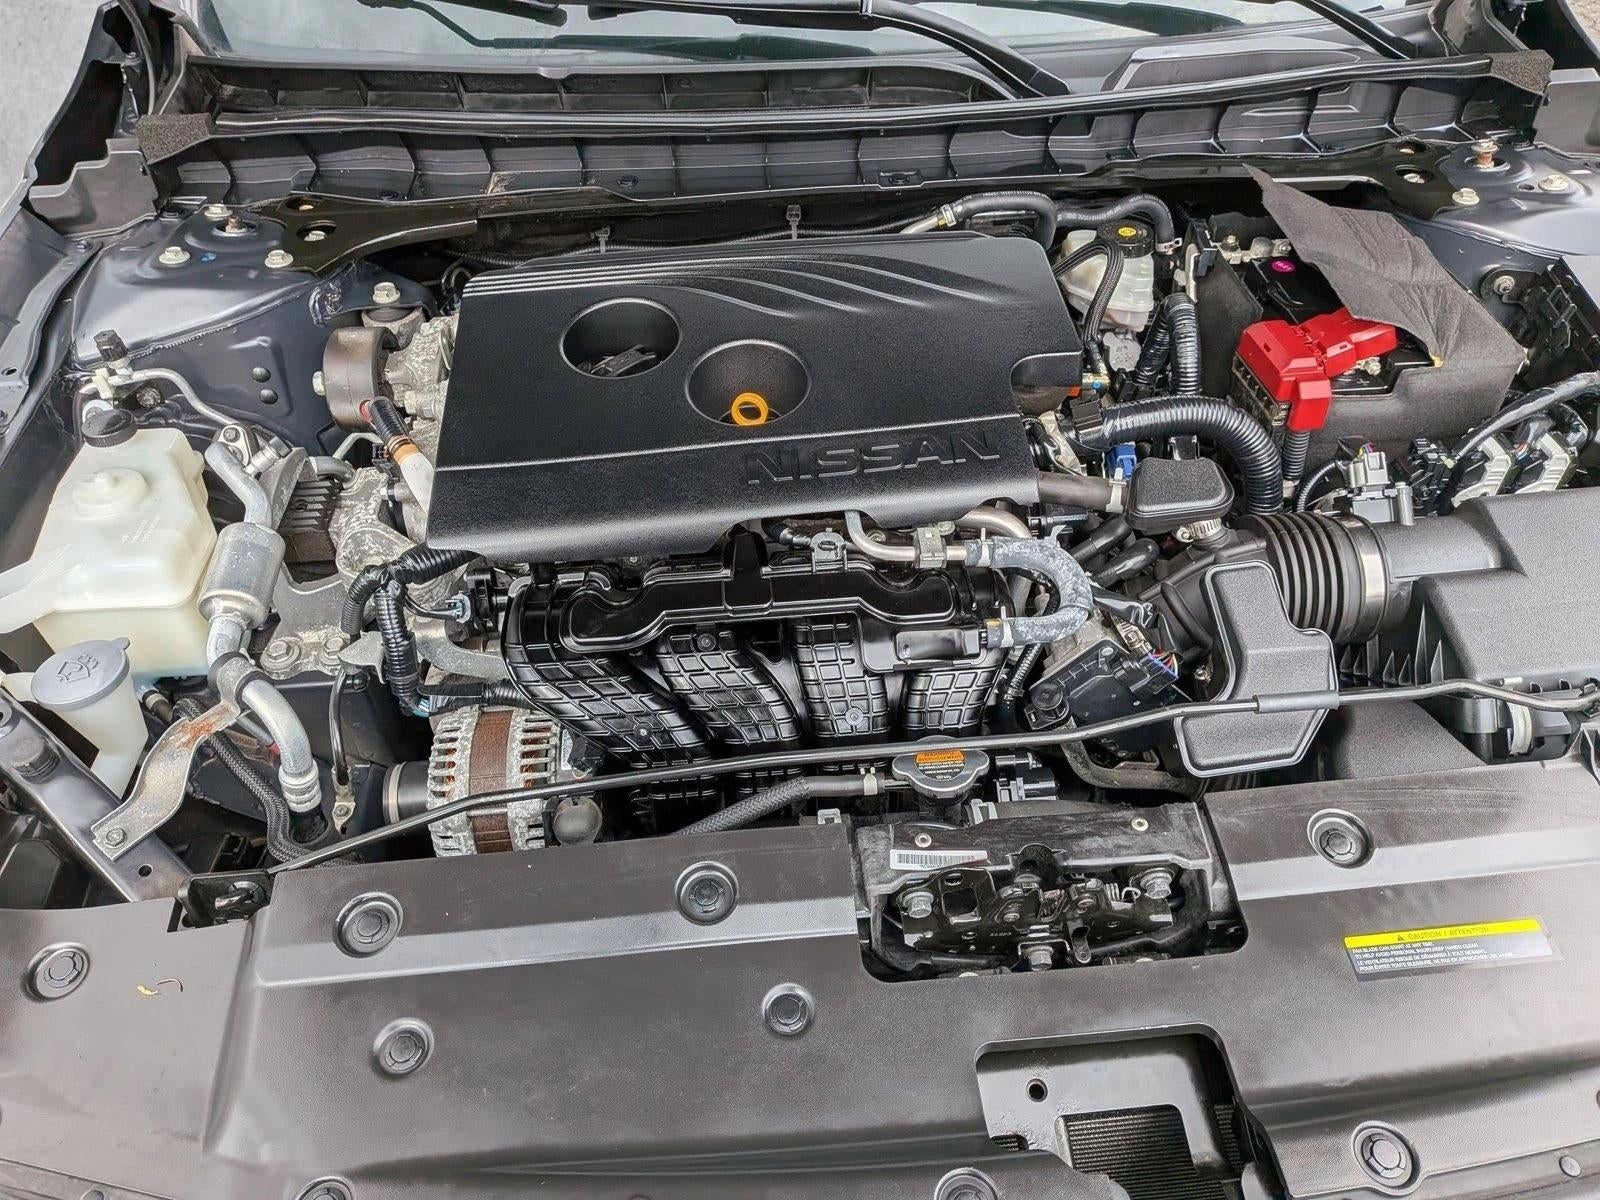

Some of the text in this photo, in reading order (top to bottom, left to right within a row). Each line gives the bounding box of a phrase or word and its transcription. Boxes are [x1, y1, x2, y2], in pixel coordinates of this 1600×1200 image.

[745, 429, 1001, 485] NISSAN
[1408, 930, 1441, 939] CAUTION
[1449, 926, 1489, 936] ATTENTION
